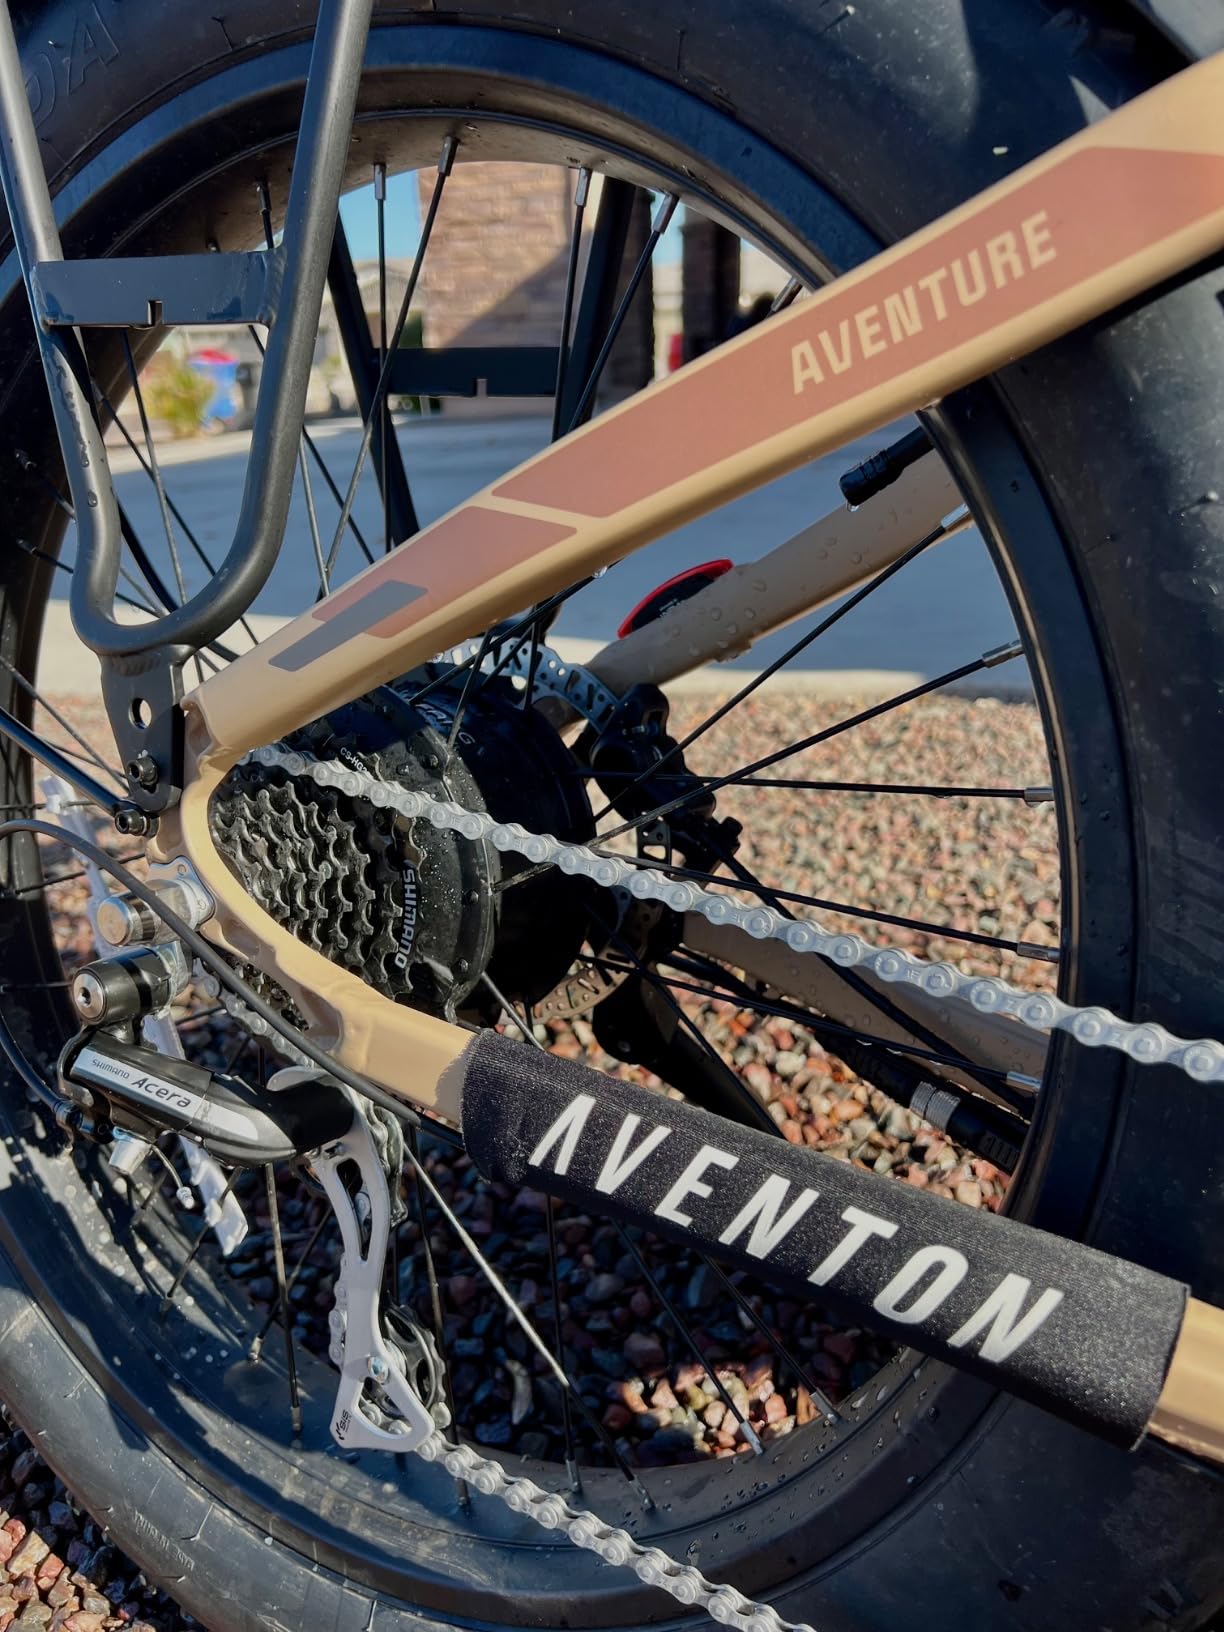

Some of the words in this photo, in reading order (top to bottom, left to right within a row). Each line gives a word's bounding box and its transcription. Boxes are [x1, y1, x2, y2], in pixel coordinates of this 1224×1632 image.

[791, 209, 1056, 395] AVENTURE
[395, 869, 417, 968] SHIMANO
[92, 1059, 130, 1079] SHIMANO
[131, 1077, 191, 1108] Acera
[529, 1094, 1064, 1364] AVENTON
